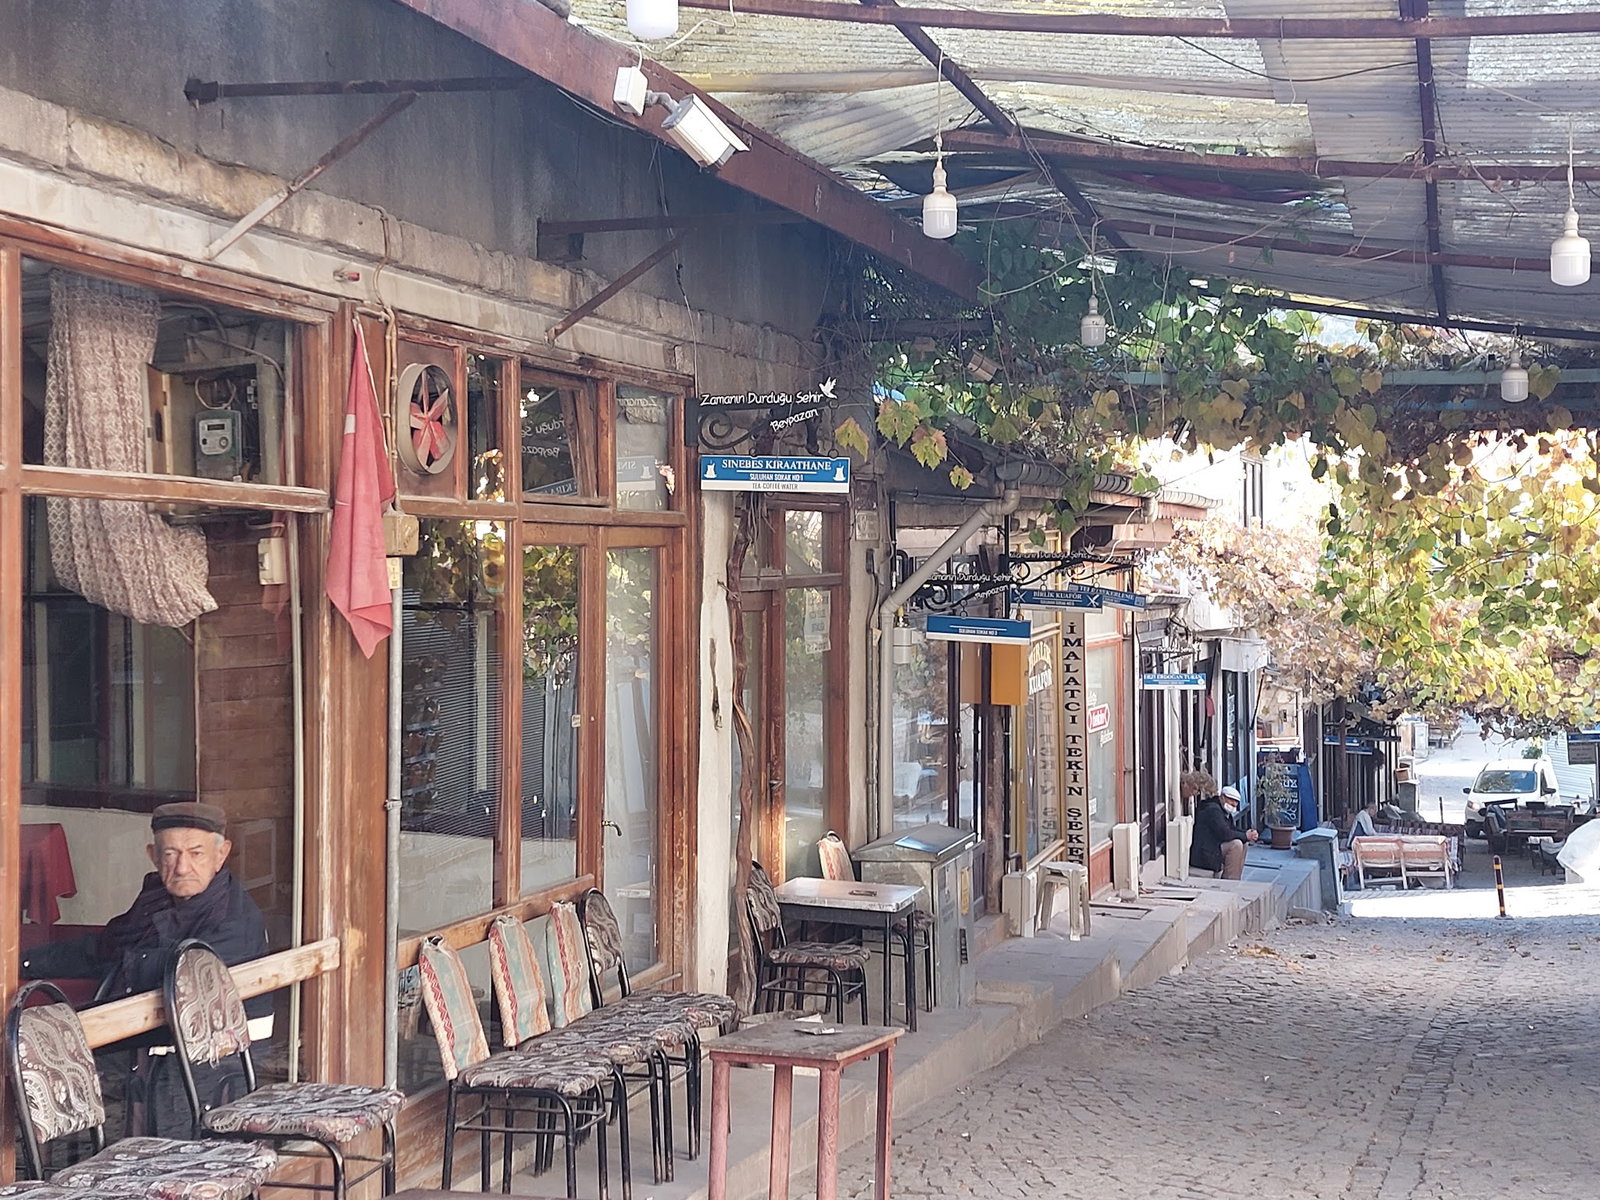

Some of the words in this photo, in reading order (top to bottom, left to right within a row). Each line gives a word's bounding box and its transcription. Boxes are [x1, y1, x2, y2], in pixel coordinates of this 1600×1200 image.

[747, 392, 792, 405] Durduğu
[766, 460, 831, 470] KIRAATHANE
[782, 483, 798, 491] WATER
[1066, 735, 1083, 796] TEKİN
[1067, 808, 1084, 865] ŞEKE
